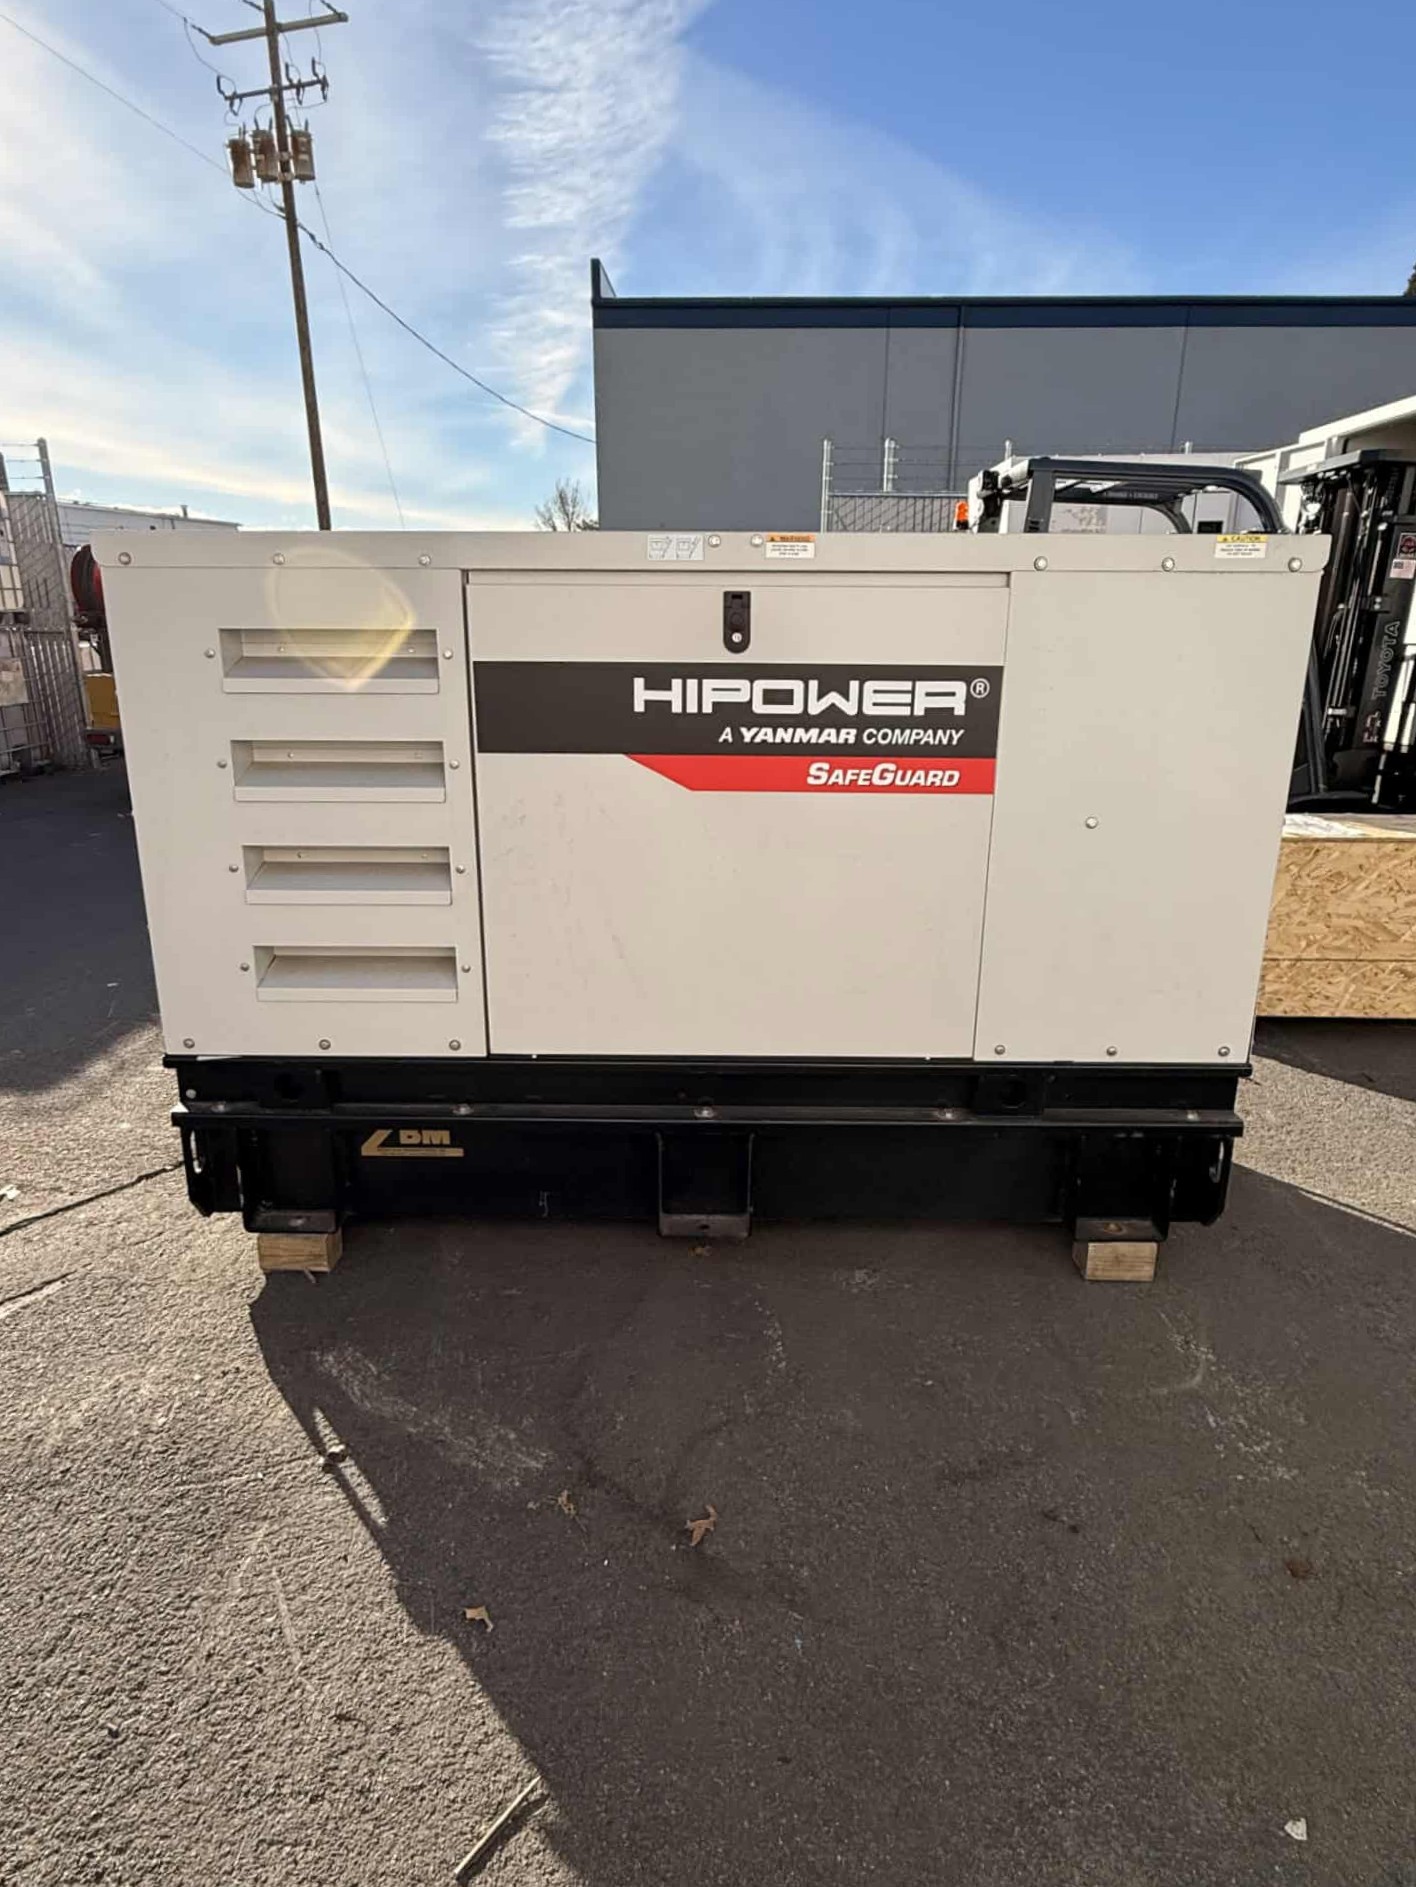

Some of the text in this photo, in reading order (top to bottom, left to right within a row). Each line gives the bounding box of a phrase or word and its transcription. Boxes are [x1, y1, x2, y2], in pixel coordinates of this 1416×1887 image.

[1372, 620, 1401, 701] TOYOTA
[719, 727, 965, 746] A YANMAR COMPANY
